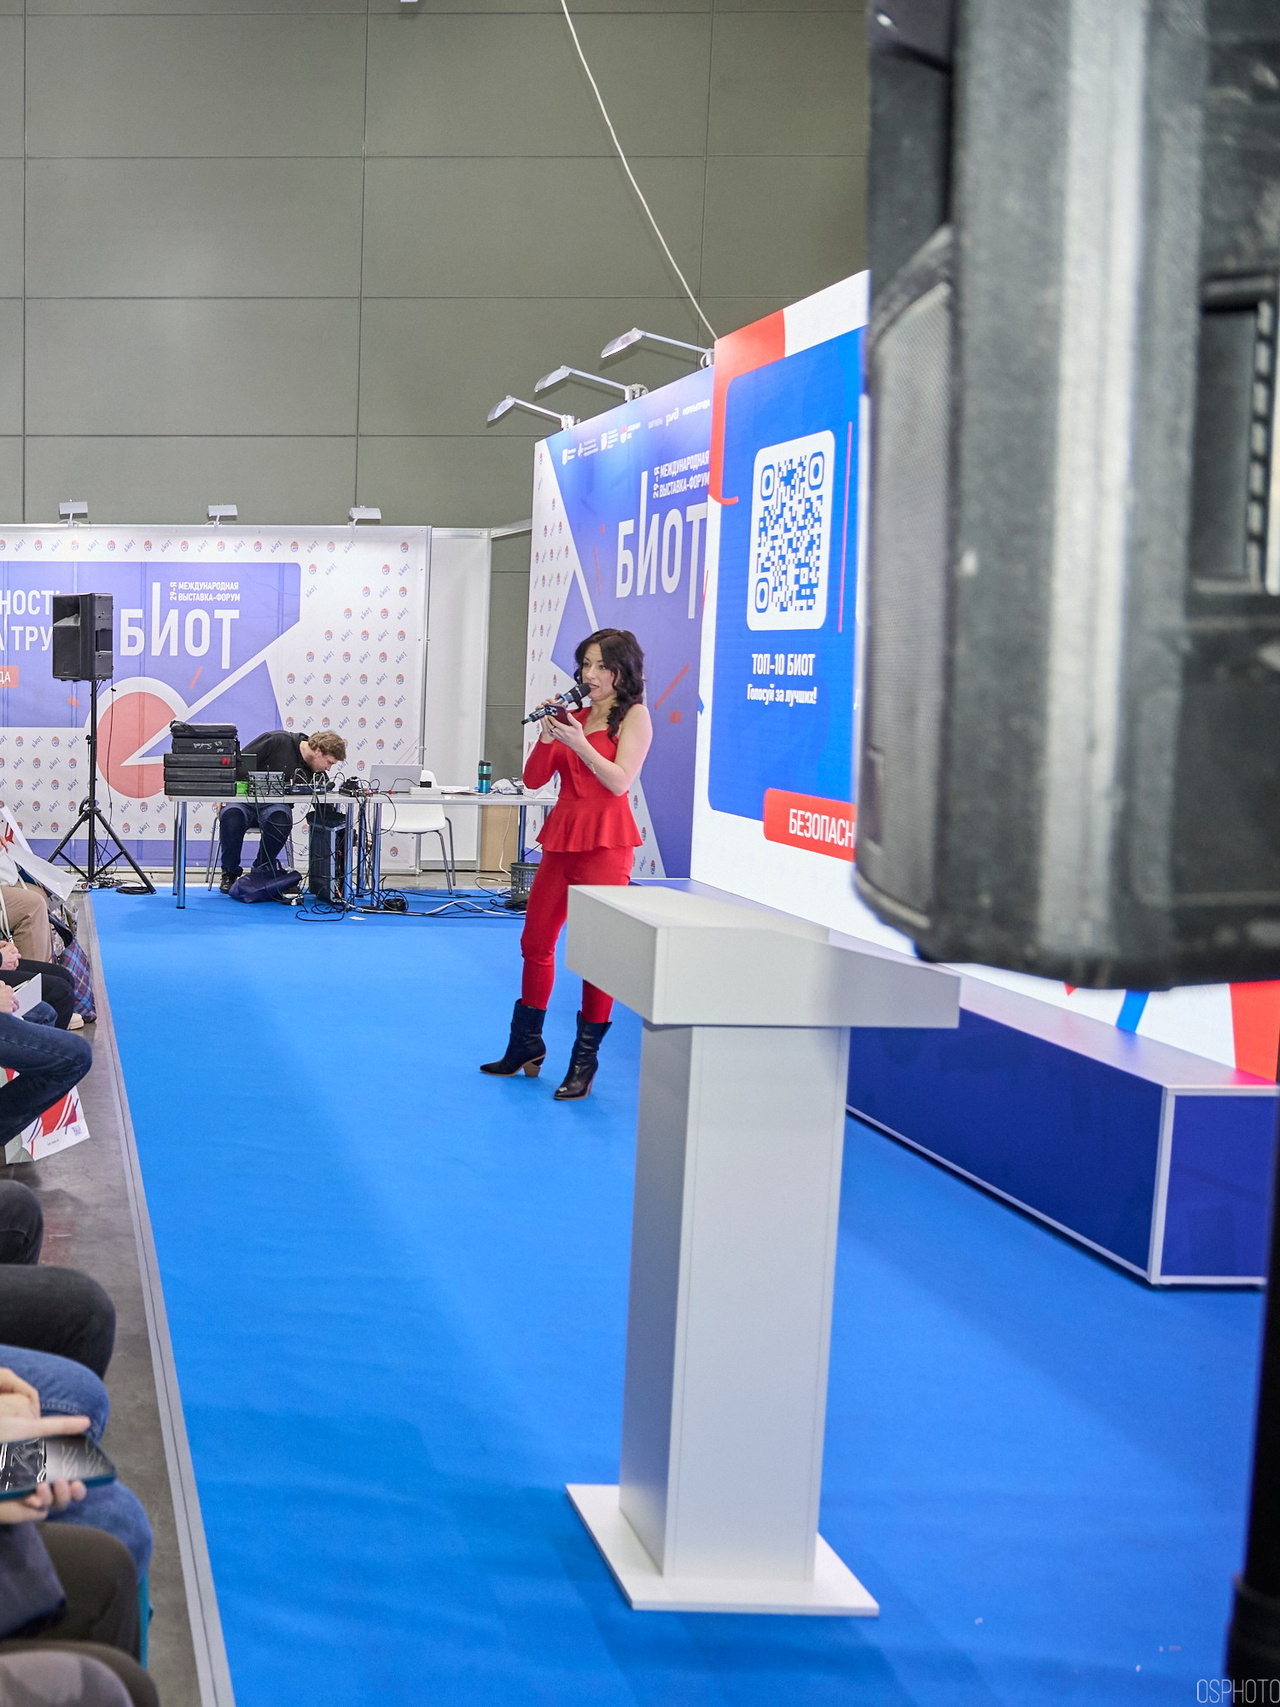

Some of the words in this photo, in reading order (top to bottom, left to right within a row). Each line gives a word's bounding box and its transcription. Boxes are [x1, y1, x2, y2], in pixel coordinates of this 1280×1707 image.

[660, 450, 710, 478] МЕЖДУНАРОДНАЯ
[659, 471, 710, 498] ВЫСТАВКА-ФОРУМ
[616, 470, 708, 620] БИОТ
[178, 582, 239, 591] МЕЖДУНАРОДНАЯ
[178, 593, 241, 601] ВЫСТАВКА-ФОРУМ
[11, 625, 53, 651] ТРУ
[120, 582, 240, 669] БИОТ
[751, 653, 785, 675] ТОП-10
[787, 653, 816, 676] БИОТ
[747, 683, 775, 705] Голосуй
[775, 689, 784, 702] за
[785, 686, 817, 707] лучших!
[789, 808, 856, 848] БЕЗОПАСН
